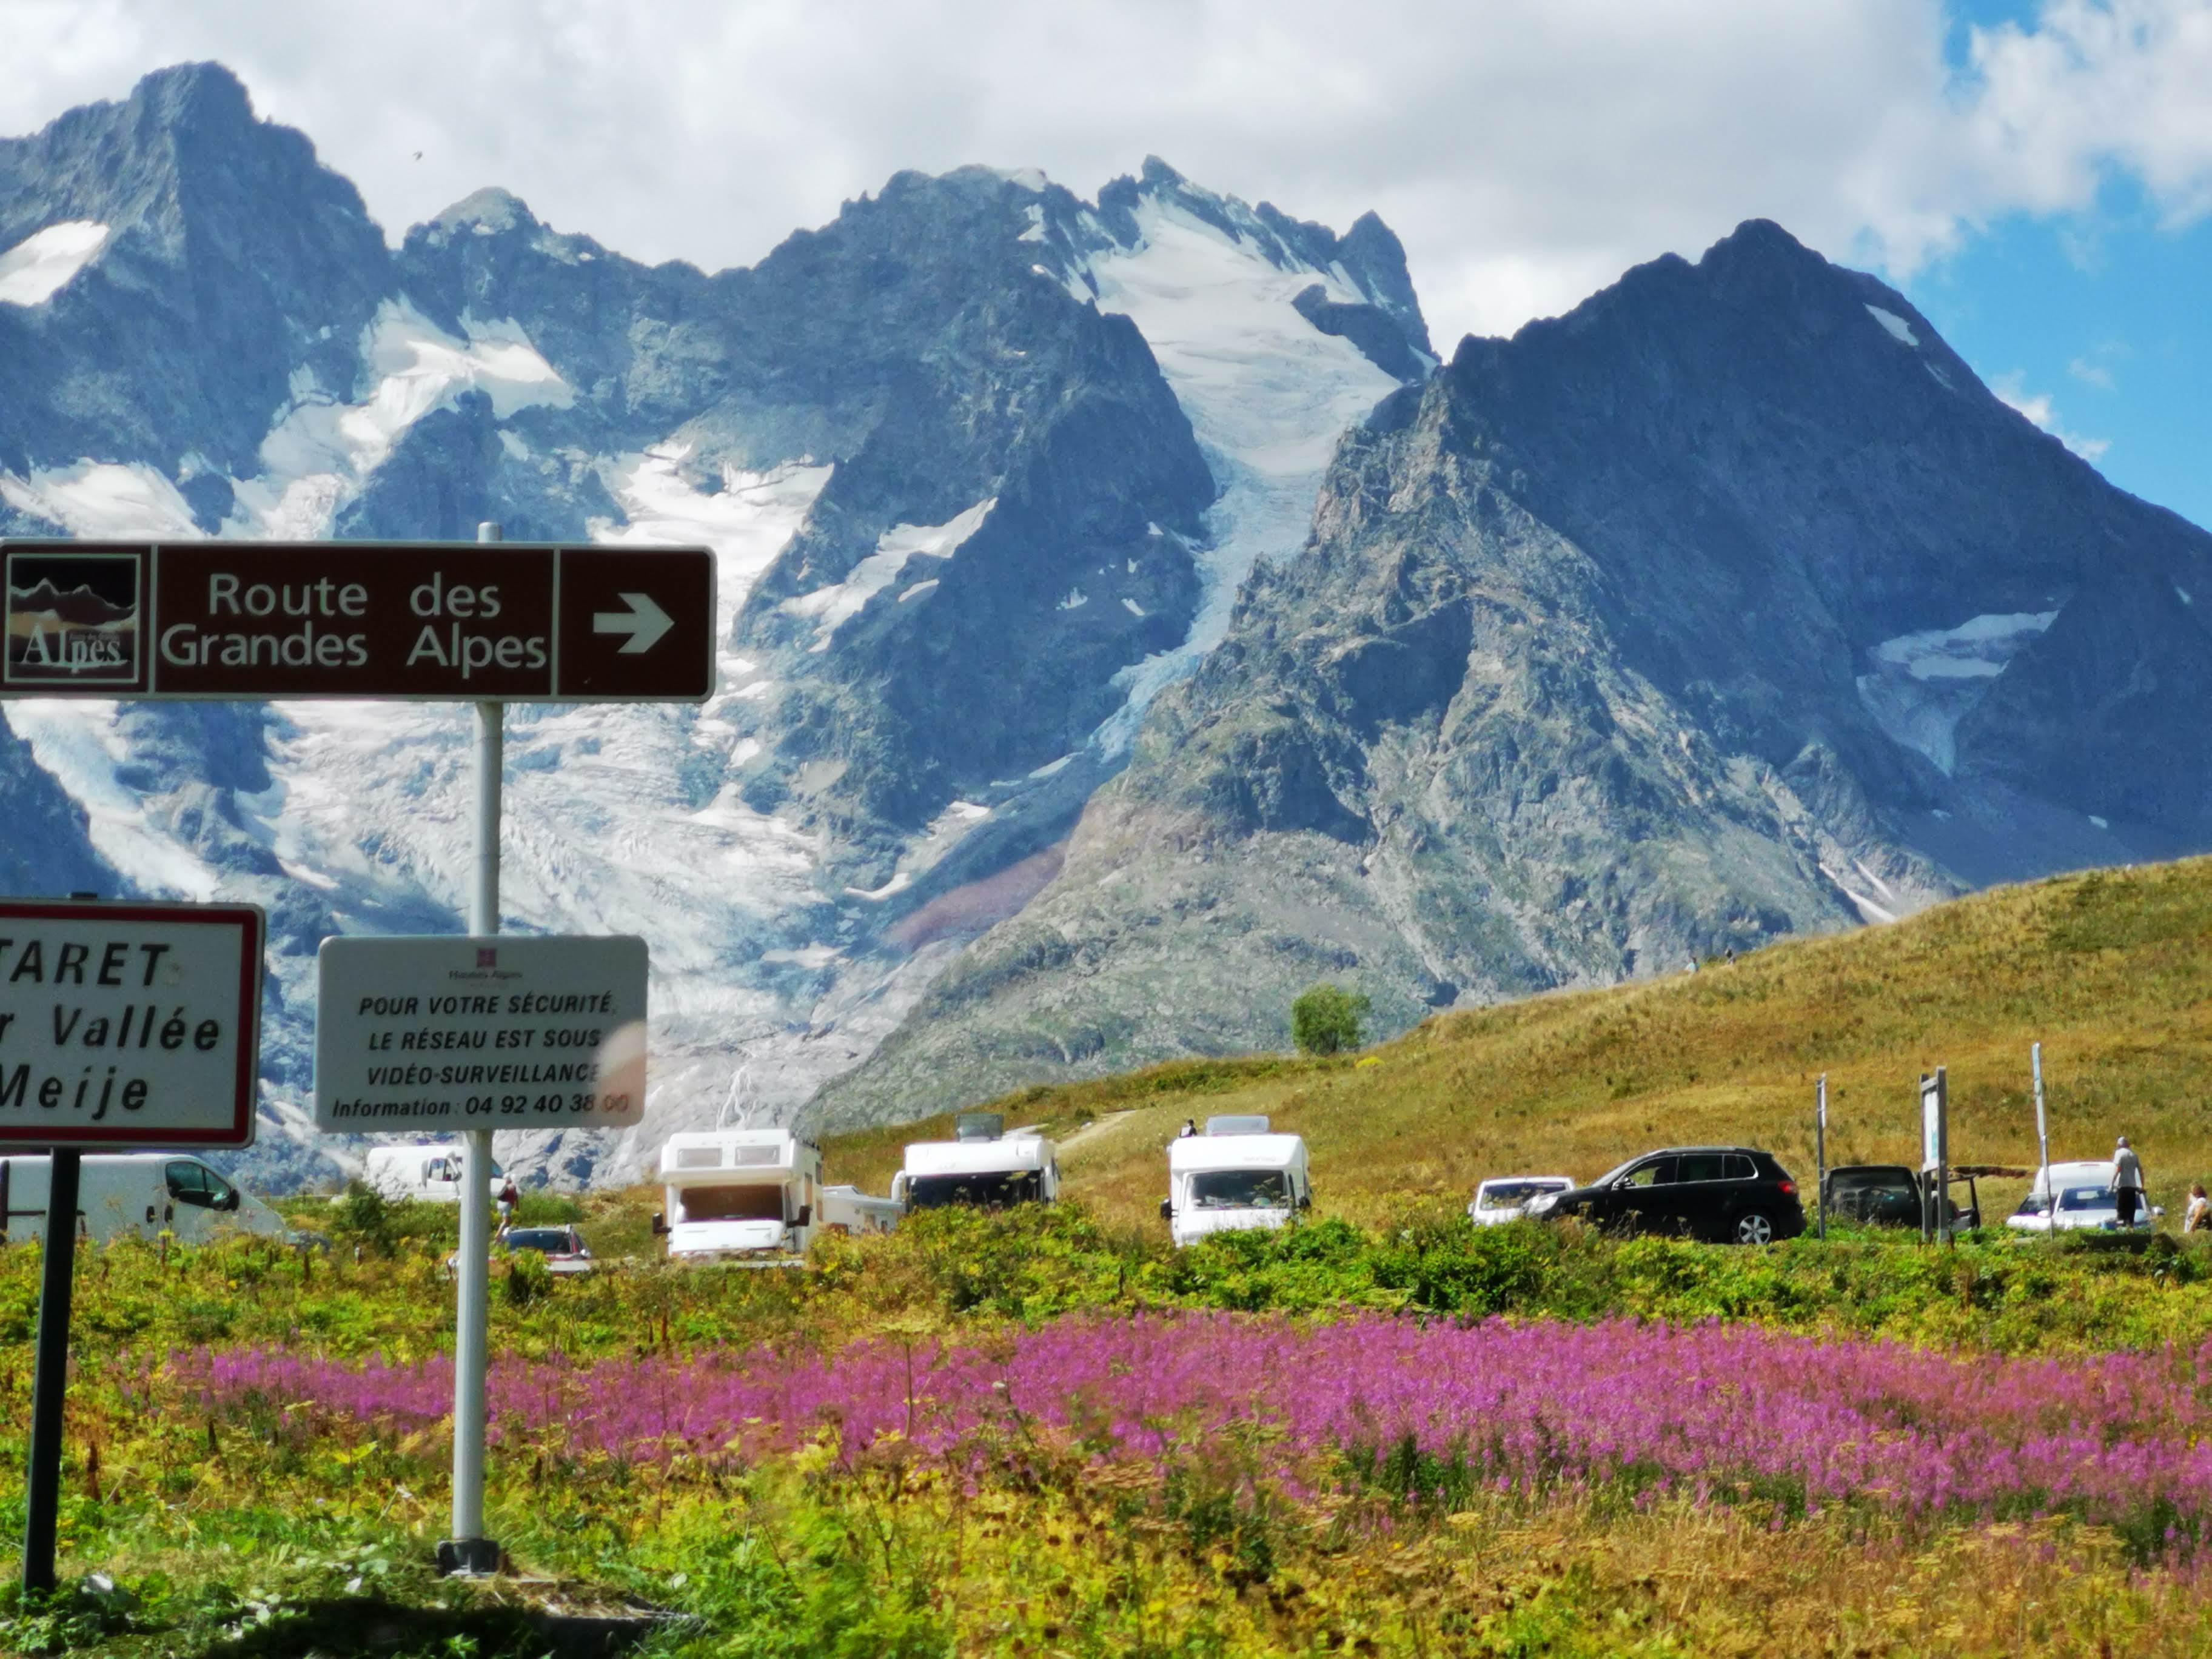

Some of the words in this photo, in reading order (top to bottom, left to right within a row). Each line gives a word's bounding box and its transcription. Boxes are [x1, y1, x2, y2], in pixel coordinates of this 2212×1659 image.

[209, 573, 368, 616] Route
[410, 571, 501, 617] des
[21, 621, 123, 674] Alpes
[160, 620, 368, 668] Grandes
[406, 622, 546, 678] Alpes
[358, 996, 418, 1016] POUR
[429, 994, 498, 1015] VOTRE
[508, 989, 617, 1015] SÉCURITÉ,
[53, 1004, 220, 1051] Vallée
[368, 1031, 392, 1050] LE
[401, 1027, 487, 1050] RÉSEAU
[495, 1029, 535, 1048] EST
[543, 1029, 601, 1048] SOUS
[332, 1098, 451, 1118] Information
[465, 1096, 492, 1114] 04
[500, 1095, 526, 1113] 92
[533, 1094, 563, 1113] 40
